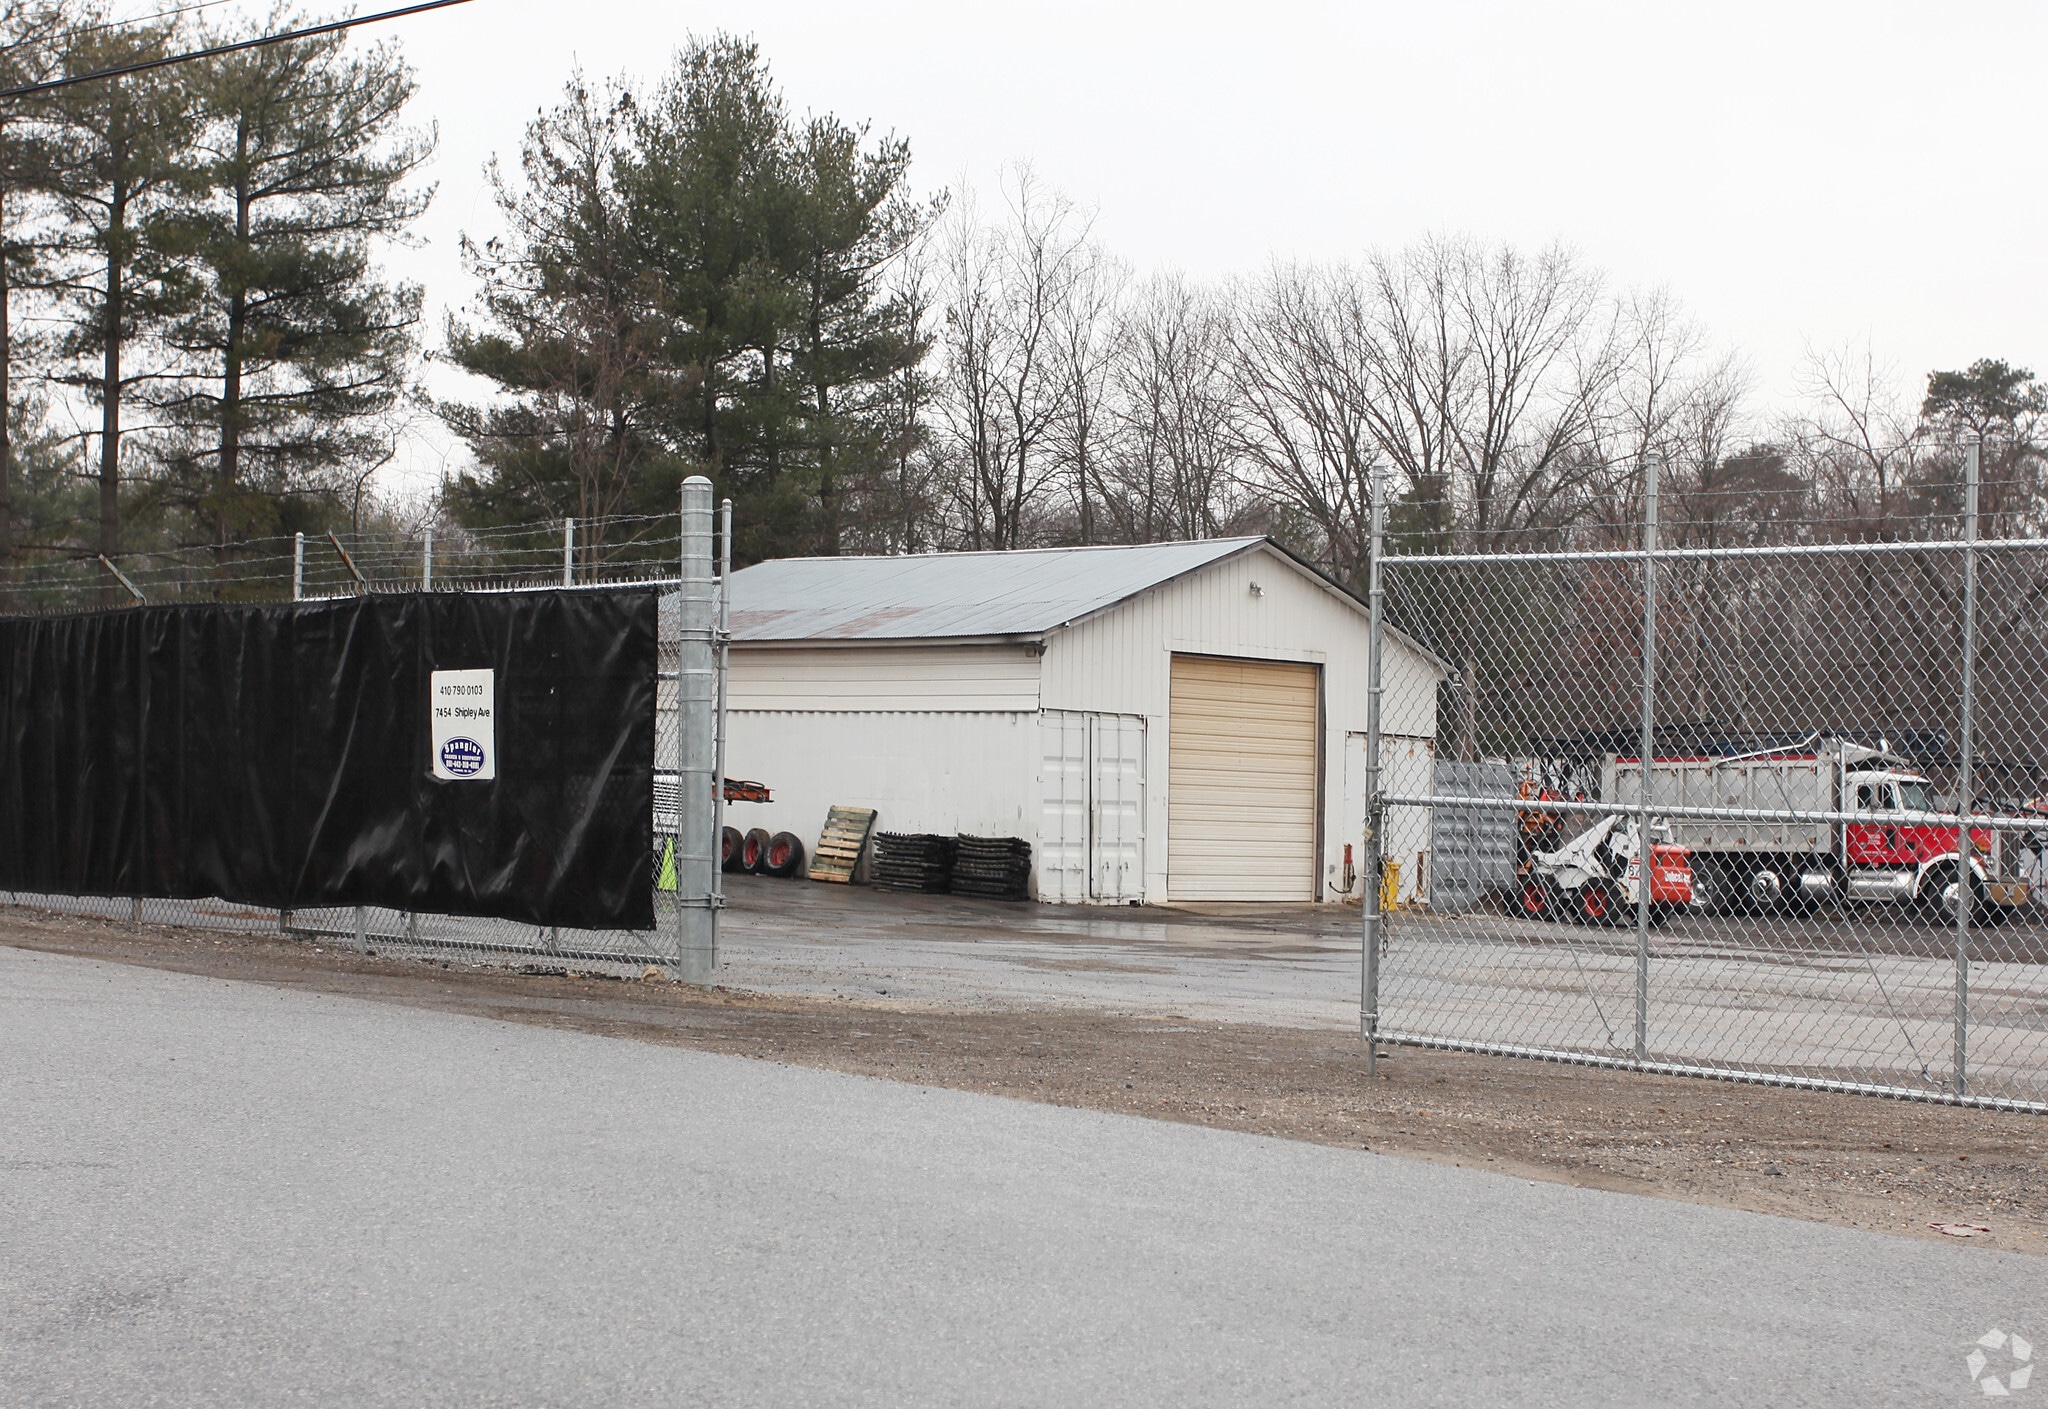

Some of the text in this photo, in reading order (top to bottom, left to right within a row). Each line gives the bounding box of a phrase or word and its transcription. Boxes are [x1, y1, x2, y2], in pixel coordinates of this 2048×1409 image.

[436, 707, 490, 720] 7454 Shipley Ave
[444, 741, 481, 755] Spangler
